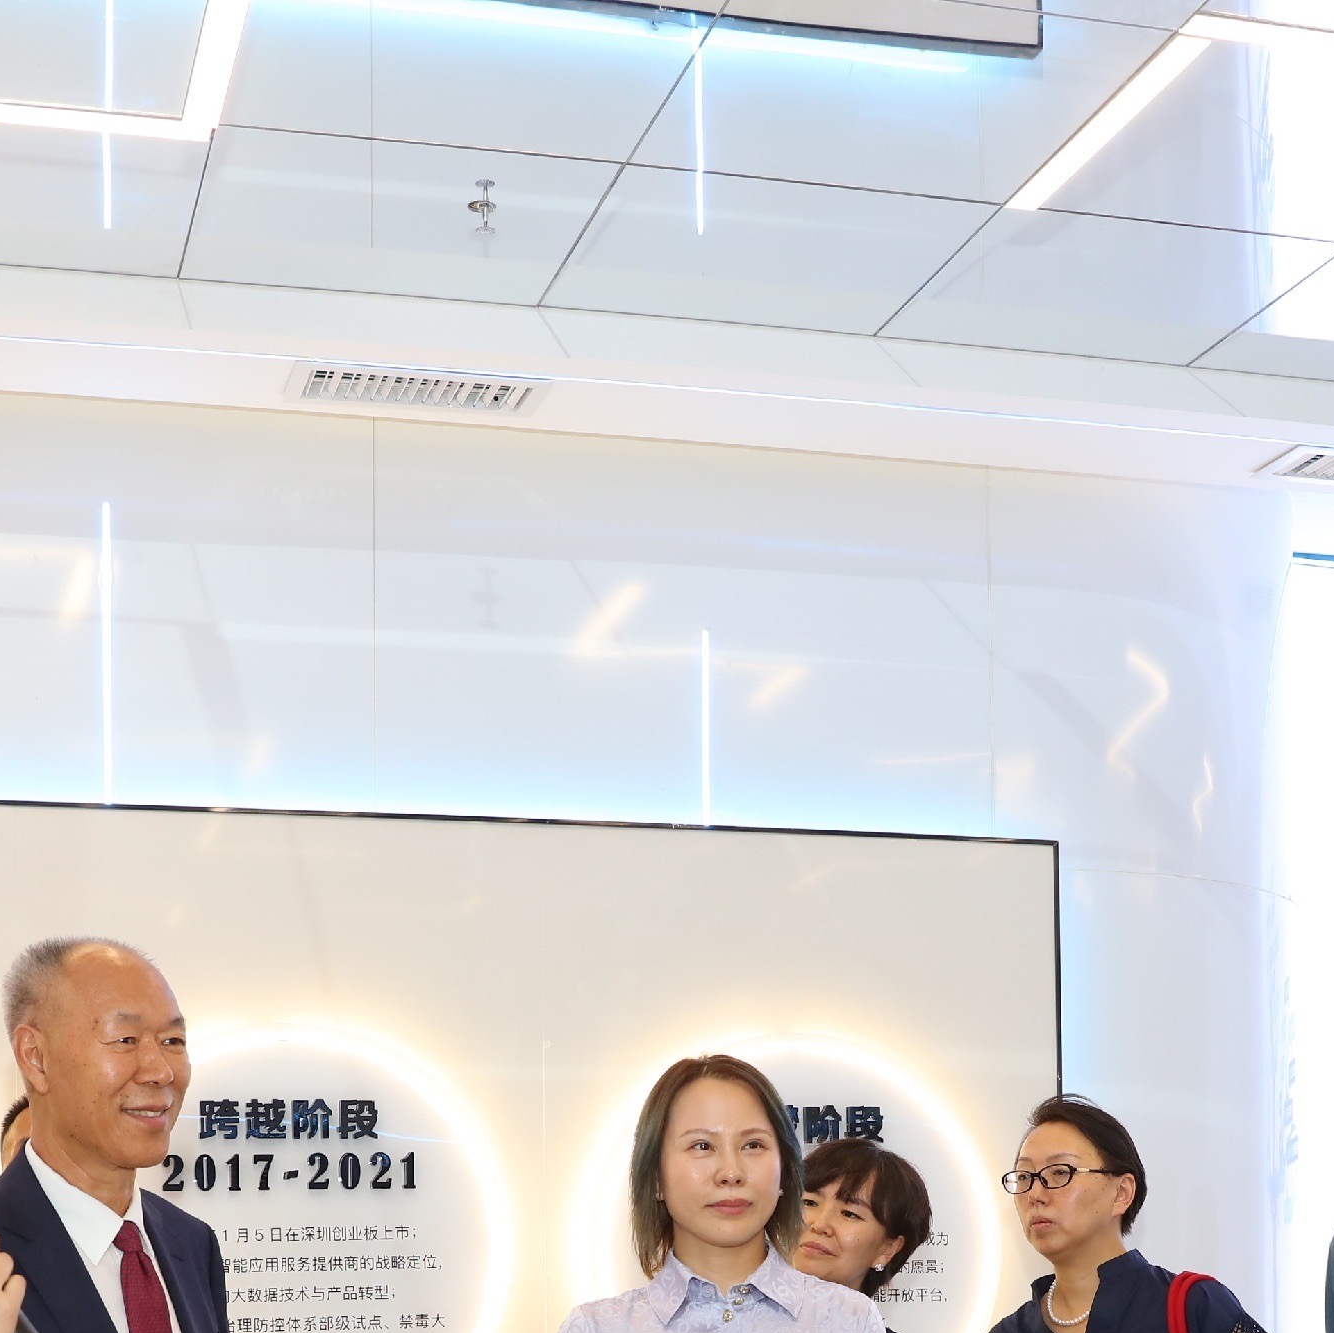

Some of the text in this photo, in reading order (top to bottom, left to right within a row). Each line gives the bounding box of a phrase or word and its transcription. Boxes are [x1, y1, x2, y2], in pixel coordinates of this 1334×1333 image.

[198, 1098, 379, 1140] 跨越阶段
[162, 1151, 417, 1192] 2017-2021
